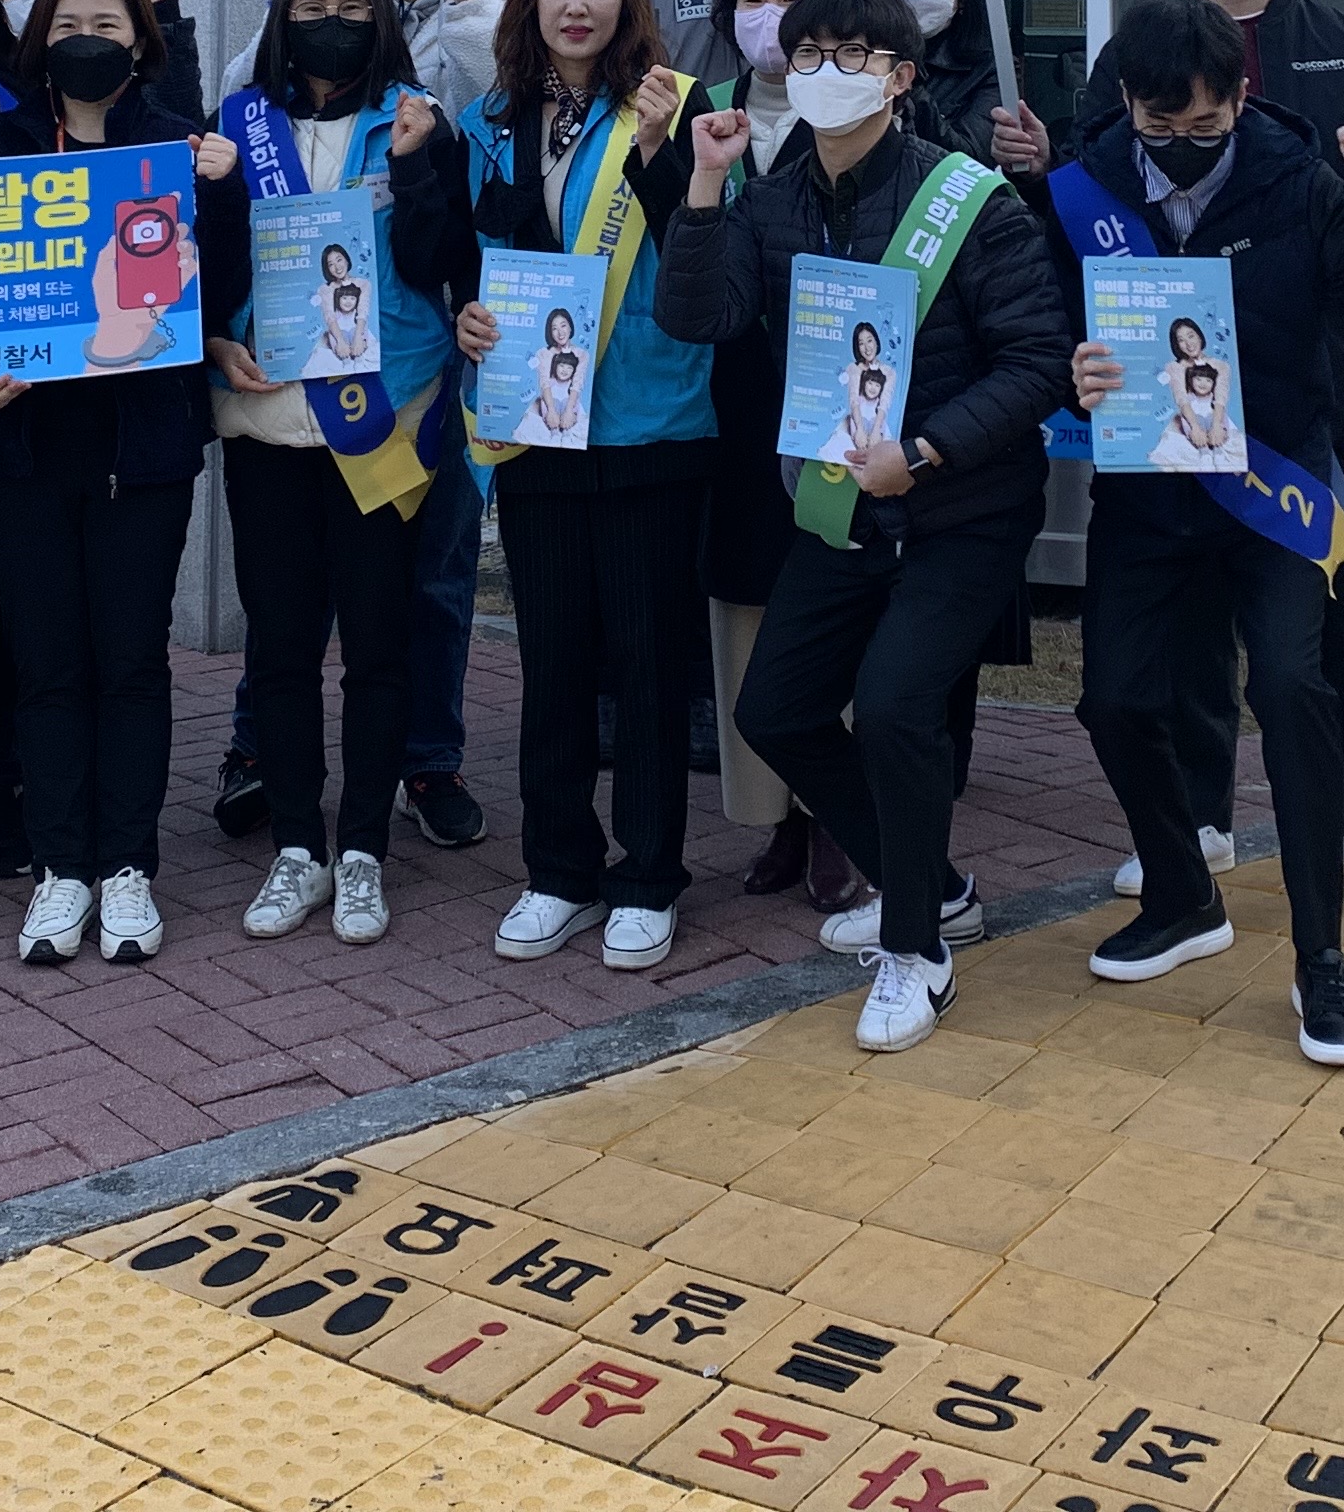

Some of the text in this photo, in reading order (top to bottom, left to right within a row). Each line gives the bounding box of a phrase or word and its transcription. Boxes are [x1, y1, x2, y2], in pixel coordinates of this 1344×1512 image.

[245, 97, 290, 199] 아동학대
[13, 283, 41, 300] 징역
[45, 280, 73, 297] 또는
[8, 301, 80, 323] 처벌됩니다
